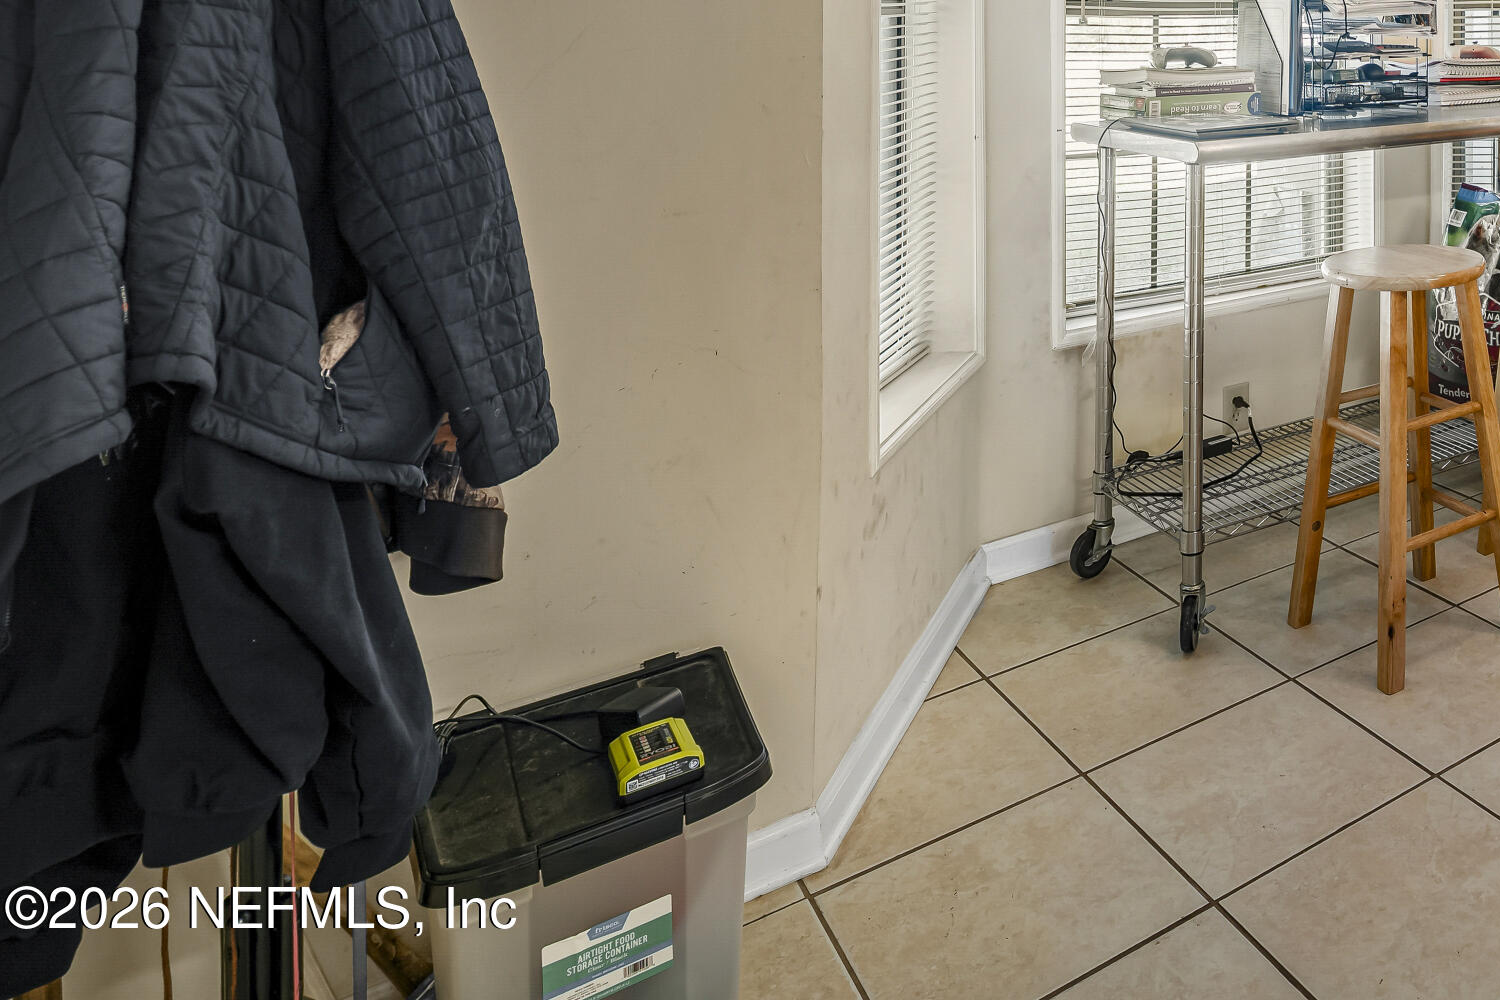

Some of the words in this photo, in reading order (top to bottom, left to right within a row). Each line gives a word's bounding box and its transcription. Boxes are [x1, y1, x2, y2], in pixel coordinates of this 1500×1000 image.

[1170, 106, 1190, 116] Read
[1201, 103, 1222, 112] Learn
[1438, 320, 1463, 341] PUP
[1438, 384, 1470, 399] Tender
[566, 954, 604, 977] STORAGE
[605, 934, 649, 960] CONTAINER
[577, 942, 613, 964] AIRTIGHT
[614, 931, 636, 947] FOOD
